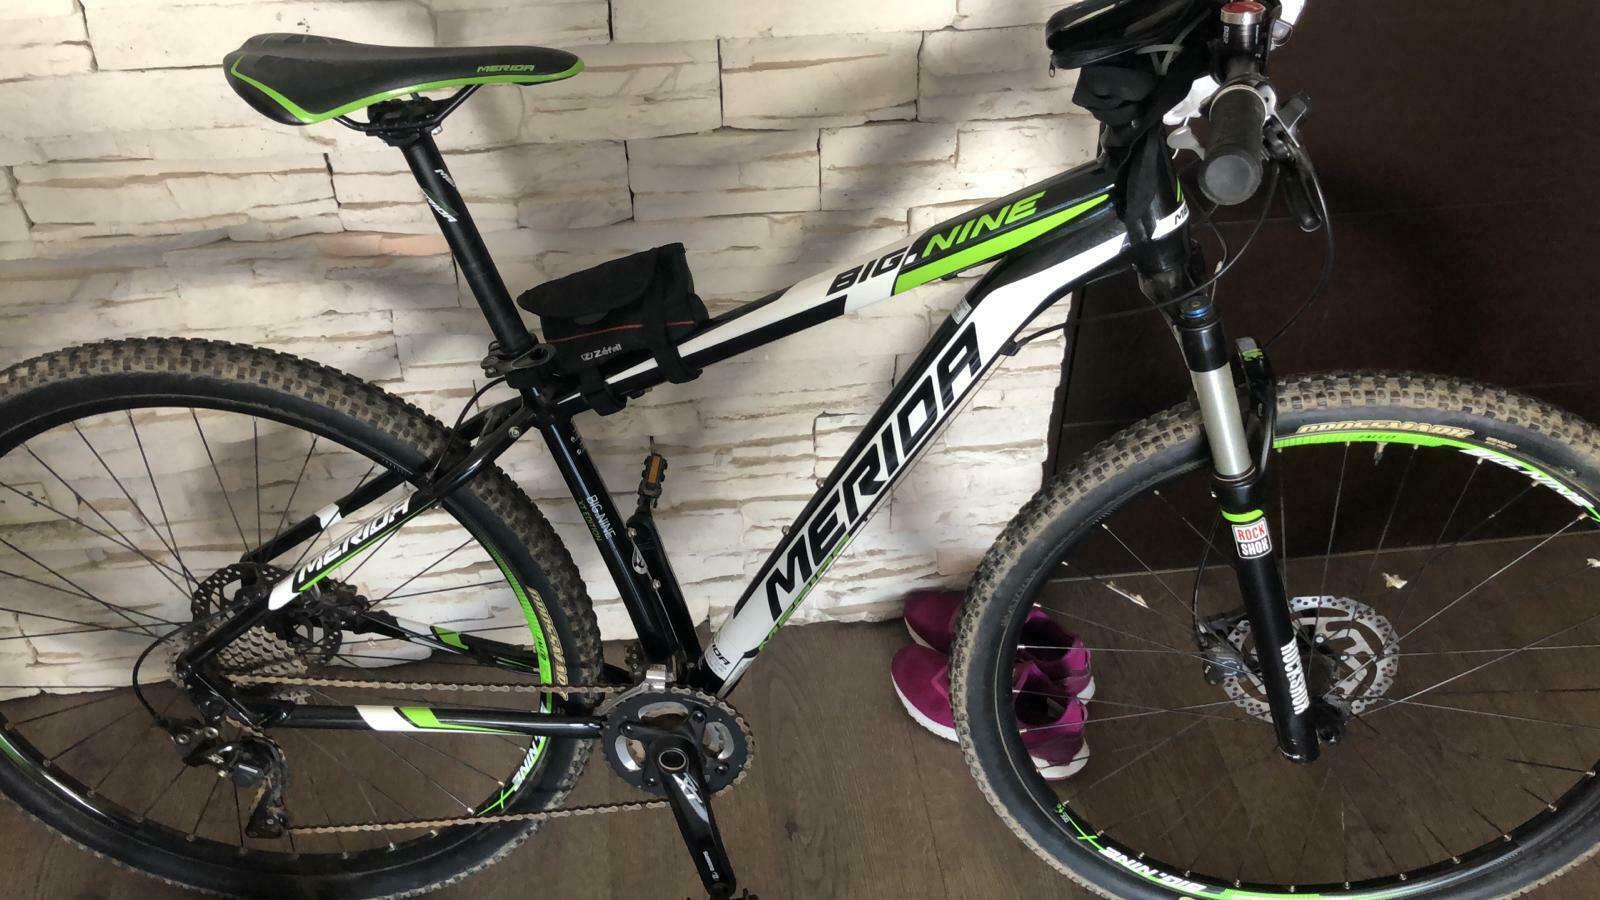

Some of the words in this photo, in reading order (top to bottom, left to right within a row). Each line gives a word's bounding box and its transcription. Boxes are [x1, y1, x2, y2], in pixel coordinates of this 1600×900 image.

[476, 64, 535, 74] MERIDA
[826, 190, 1048, 297] BIG.NINE
[765, 321, 982, 623] MERIDA
[296, 494, 413, 584] MERIDA
[587, 494, 616, 540] BIG.NINE
[1237, 523, 1265, 542] ROCK
[1240, 538, 1270, 557] SHOX
